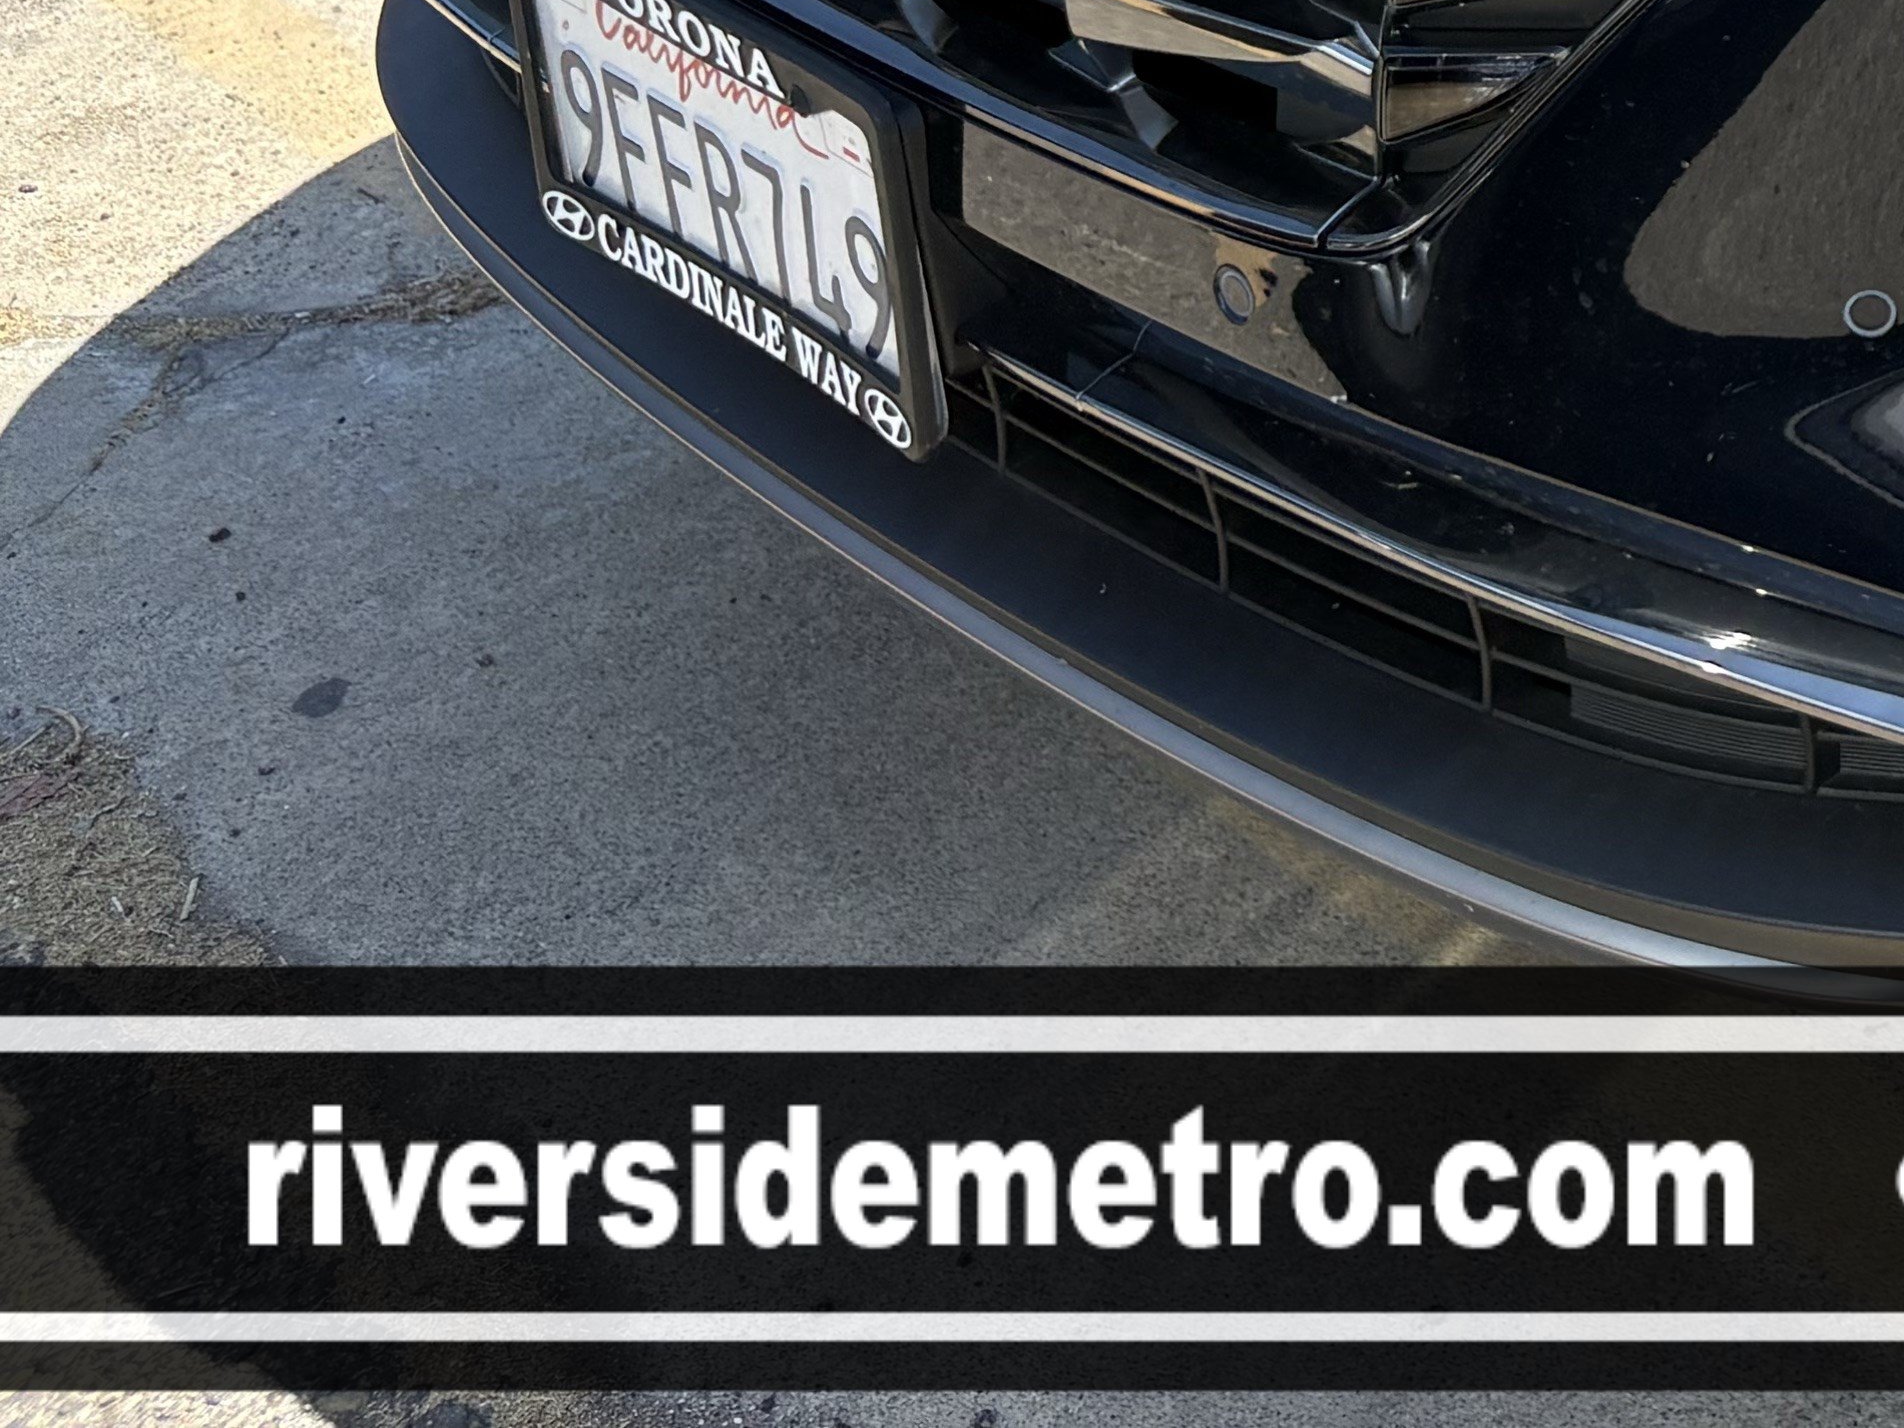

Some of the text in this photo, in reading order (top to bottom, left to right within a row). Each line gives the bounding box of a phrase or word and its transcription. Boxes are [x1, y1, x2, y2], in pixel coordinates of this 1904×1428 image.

[559, 48, 894, 361] 9FFR749
[597, 212, 864, 416] CARDINALE WAY
